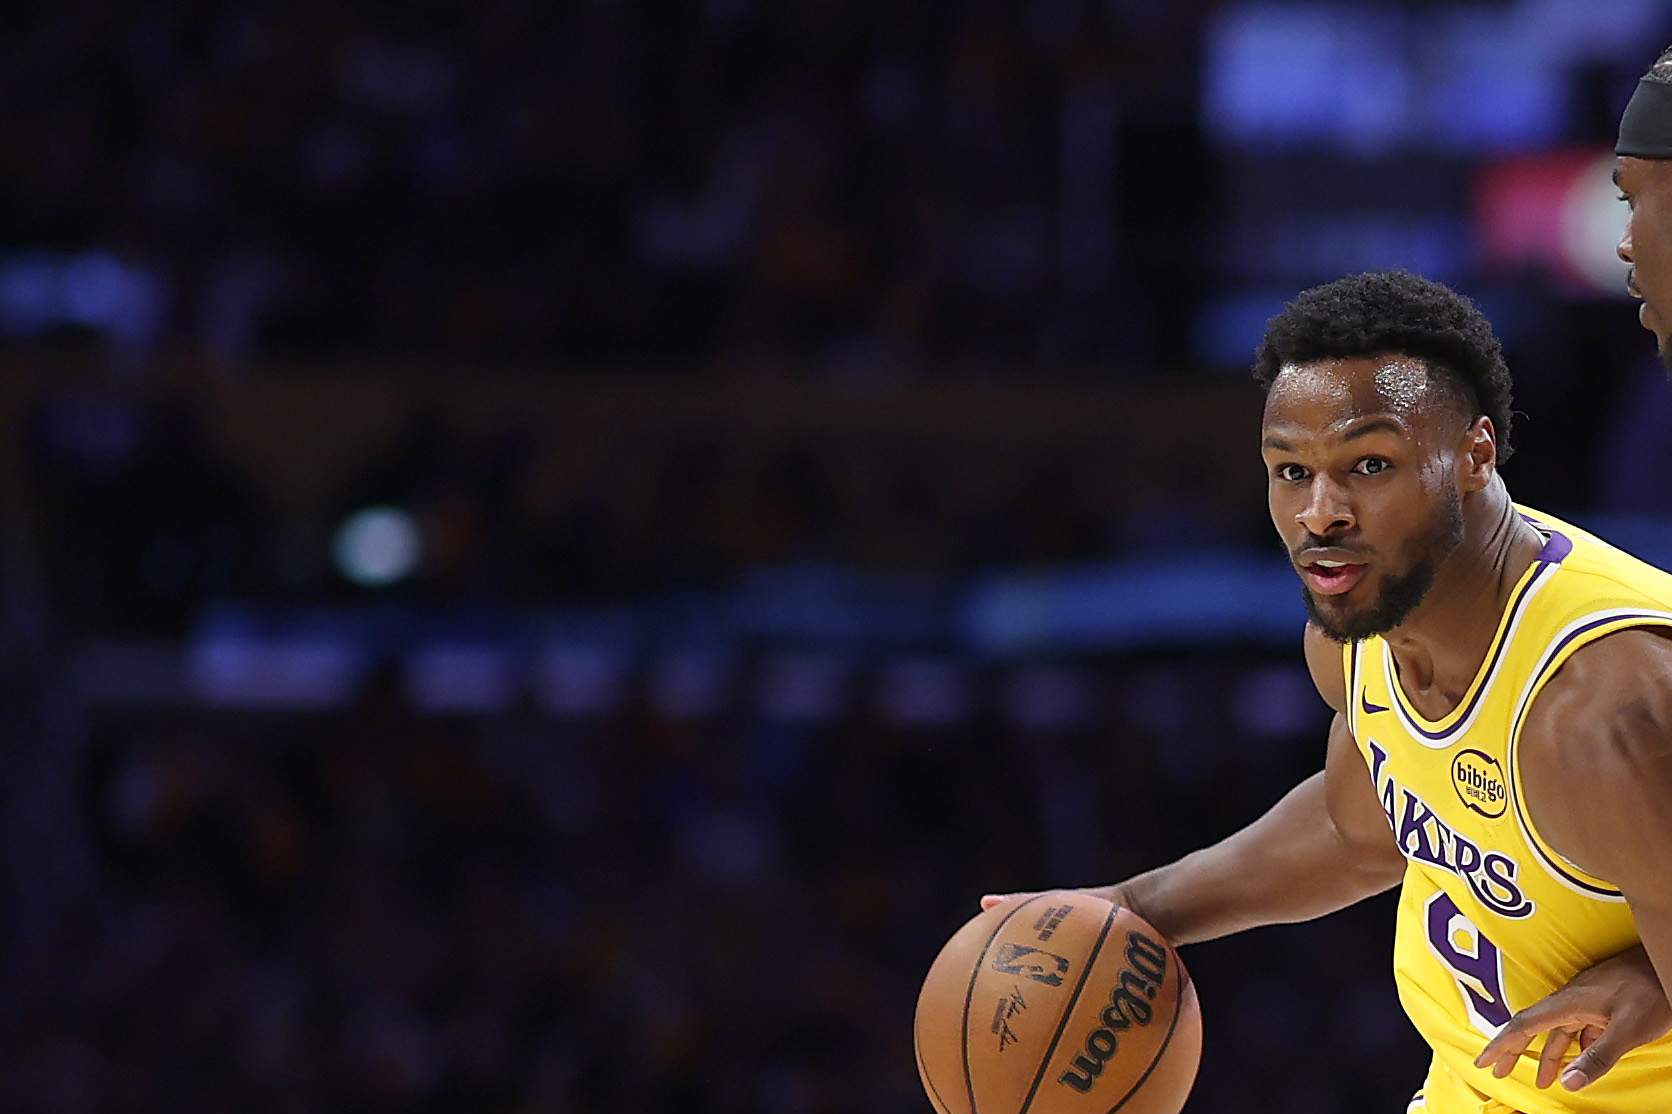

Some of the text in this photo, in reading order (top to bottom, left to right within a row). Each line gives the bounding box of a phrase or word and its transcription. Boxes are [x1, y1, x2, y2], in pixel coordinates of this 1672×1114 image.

[1457, 761, 1504, 802] bibigo
[1058, 931, 1168, 1094] Wilson
[1428, 891, 1512, 1028] 9
